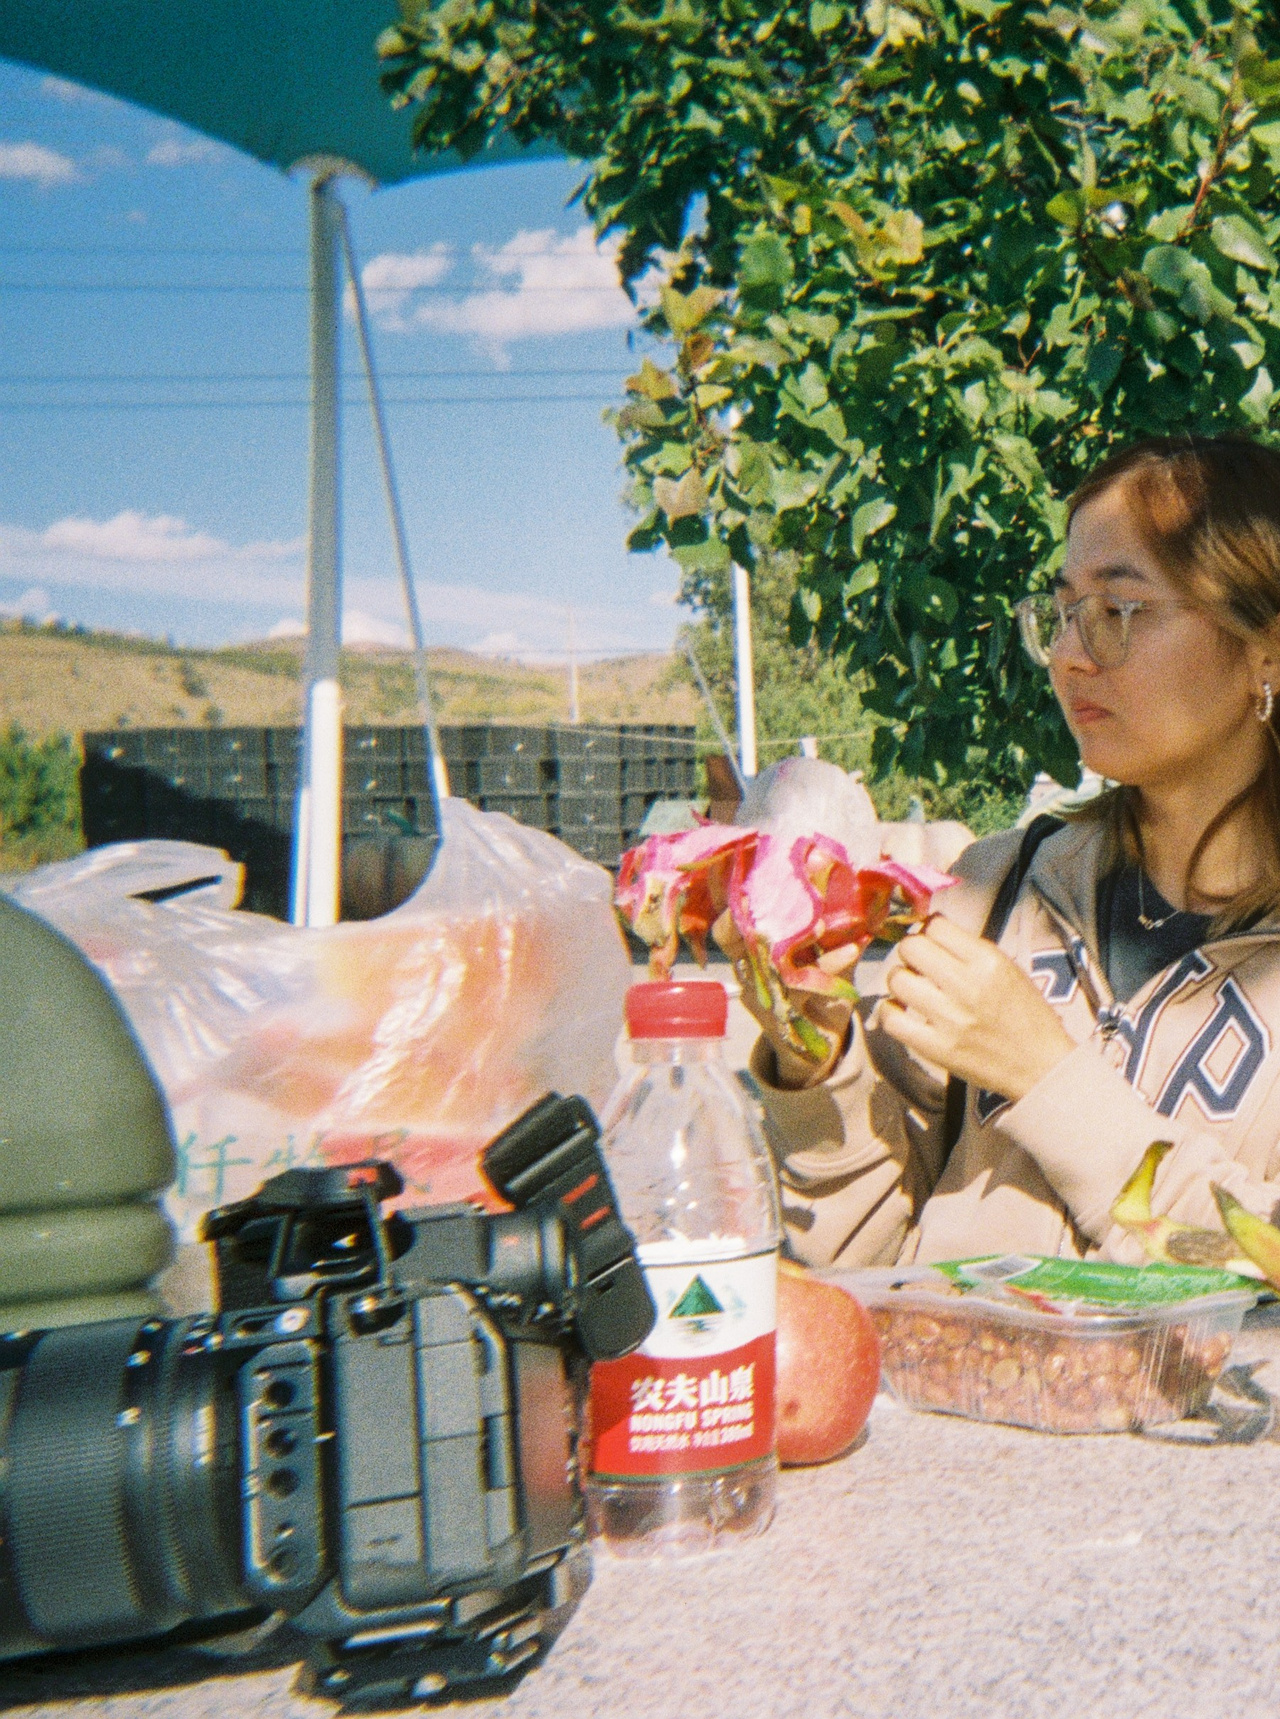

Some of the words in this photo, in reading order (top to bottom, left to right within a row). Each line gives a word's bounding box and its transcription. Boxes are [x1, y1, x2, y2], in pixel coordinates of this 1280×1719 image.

[630, 1363, 755, 1412] 农夫山泉
[629, 1411, 697, 1433] NONGFU
